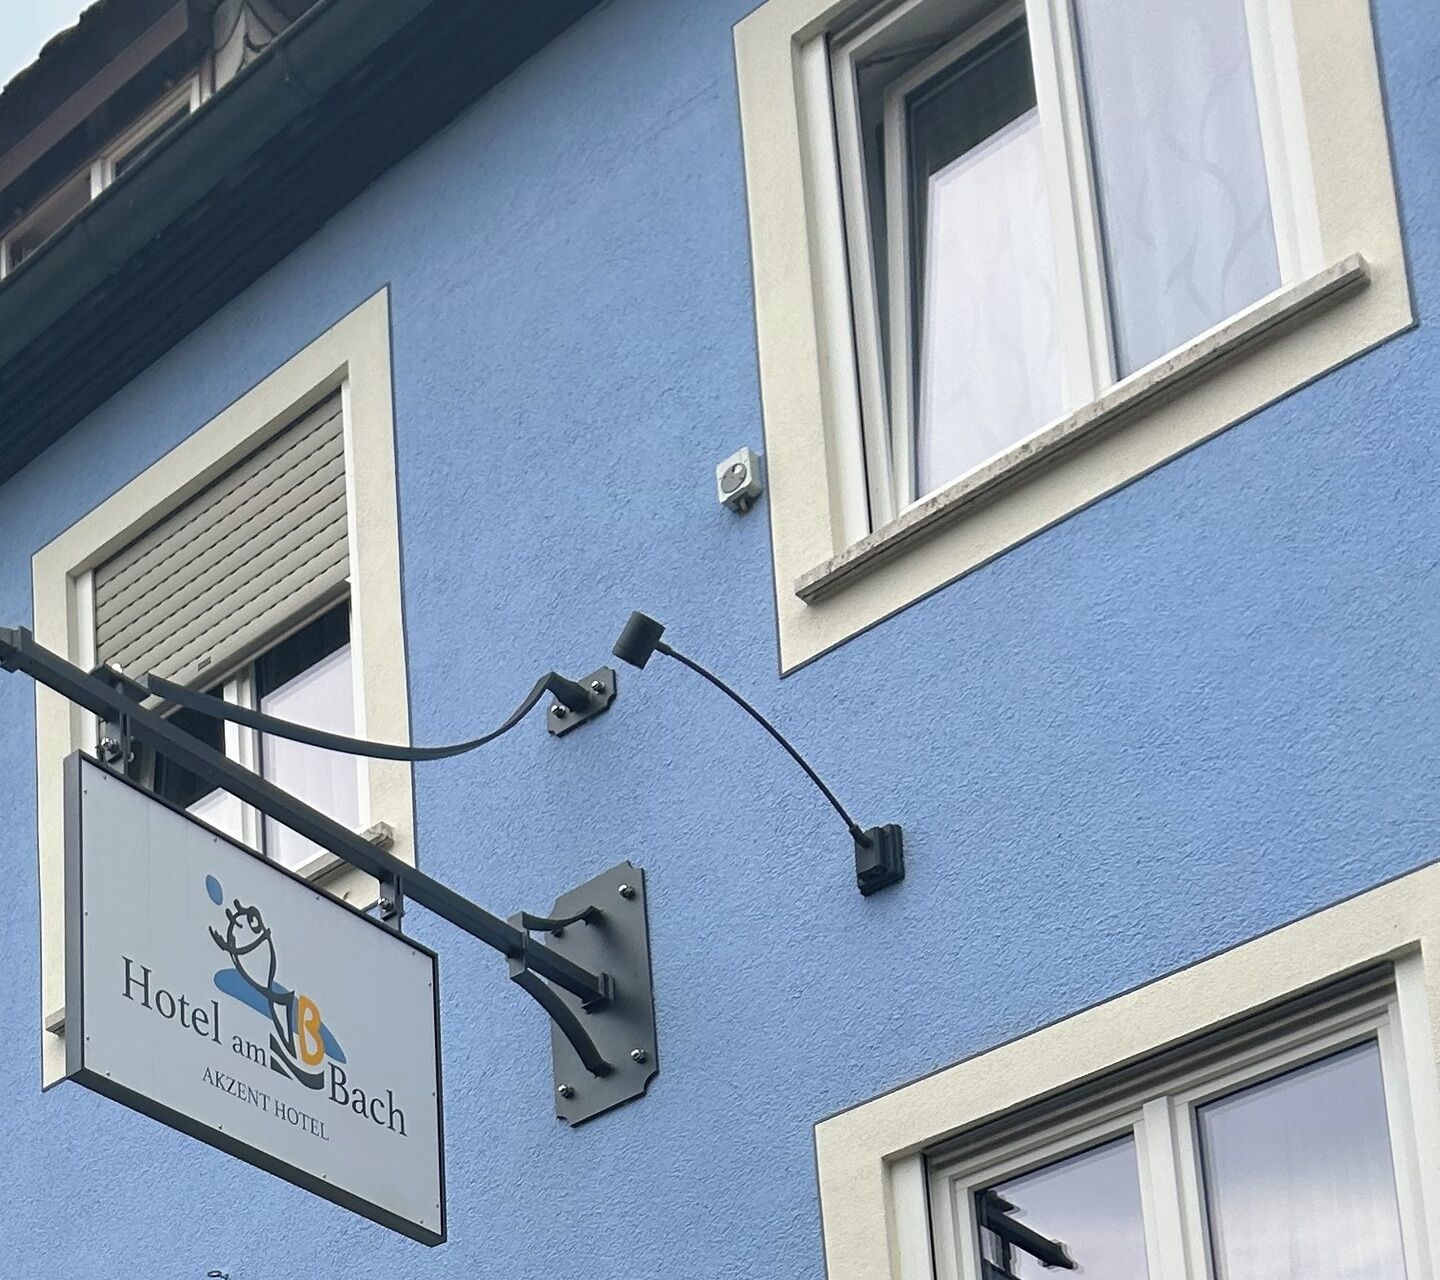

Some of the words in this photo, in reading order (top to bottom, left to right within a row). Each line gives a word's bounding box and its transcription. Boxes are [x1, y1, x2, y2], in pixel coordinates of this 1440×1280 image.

[121, 955, 223, 1045] Hotel
[232, 1034, 268, 1068] am
[327, 1062, 407, 1137] Bach
[202, 1066, 271, 1113] AKZENT
[273, 1100, 330, 1141] HOTEL
